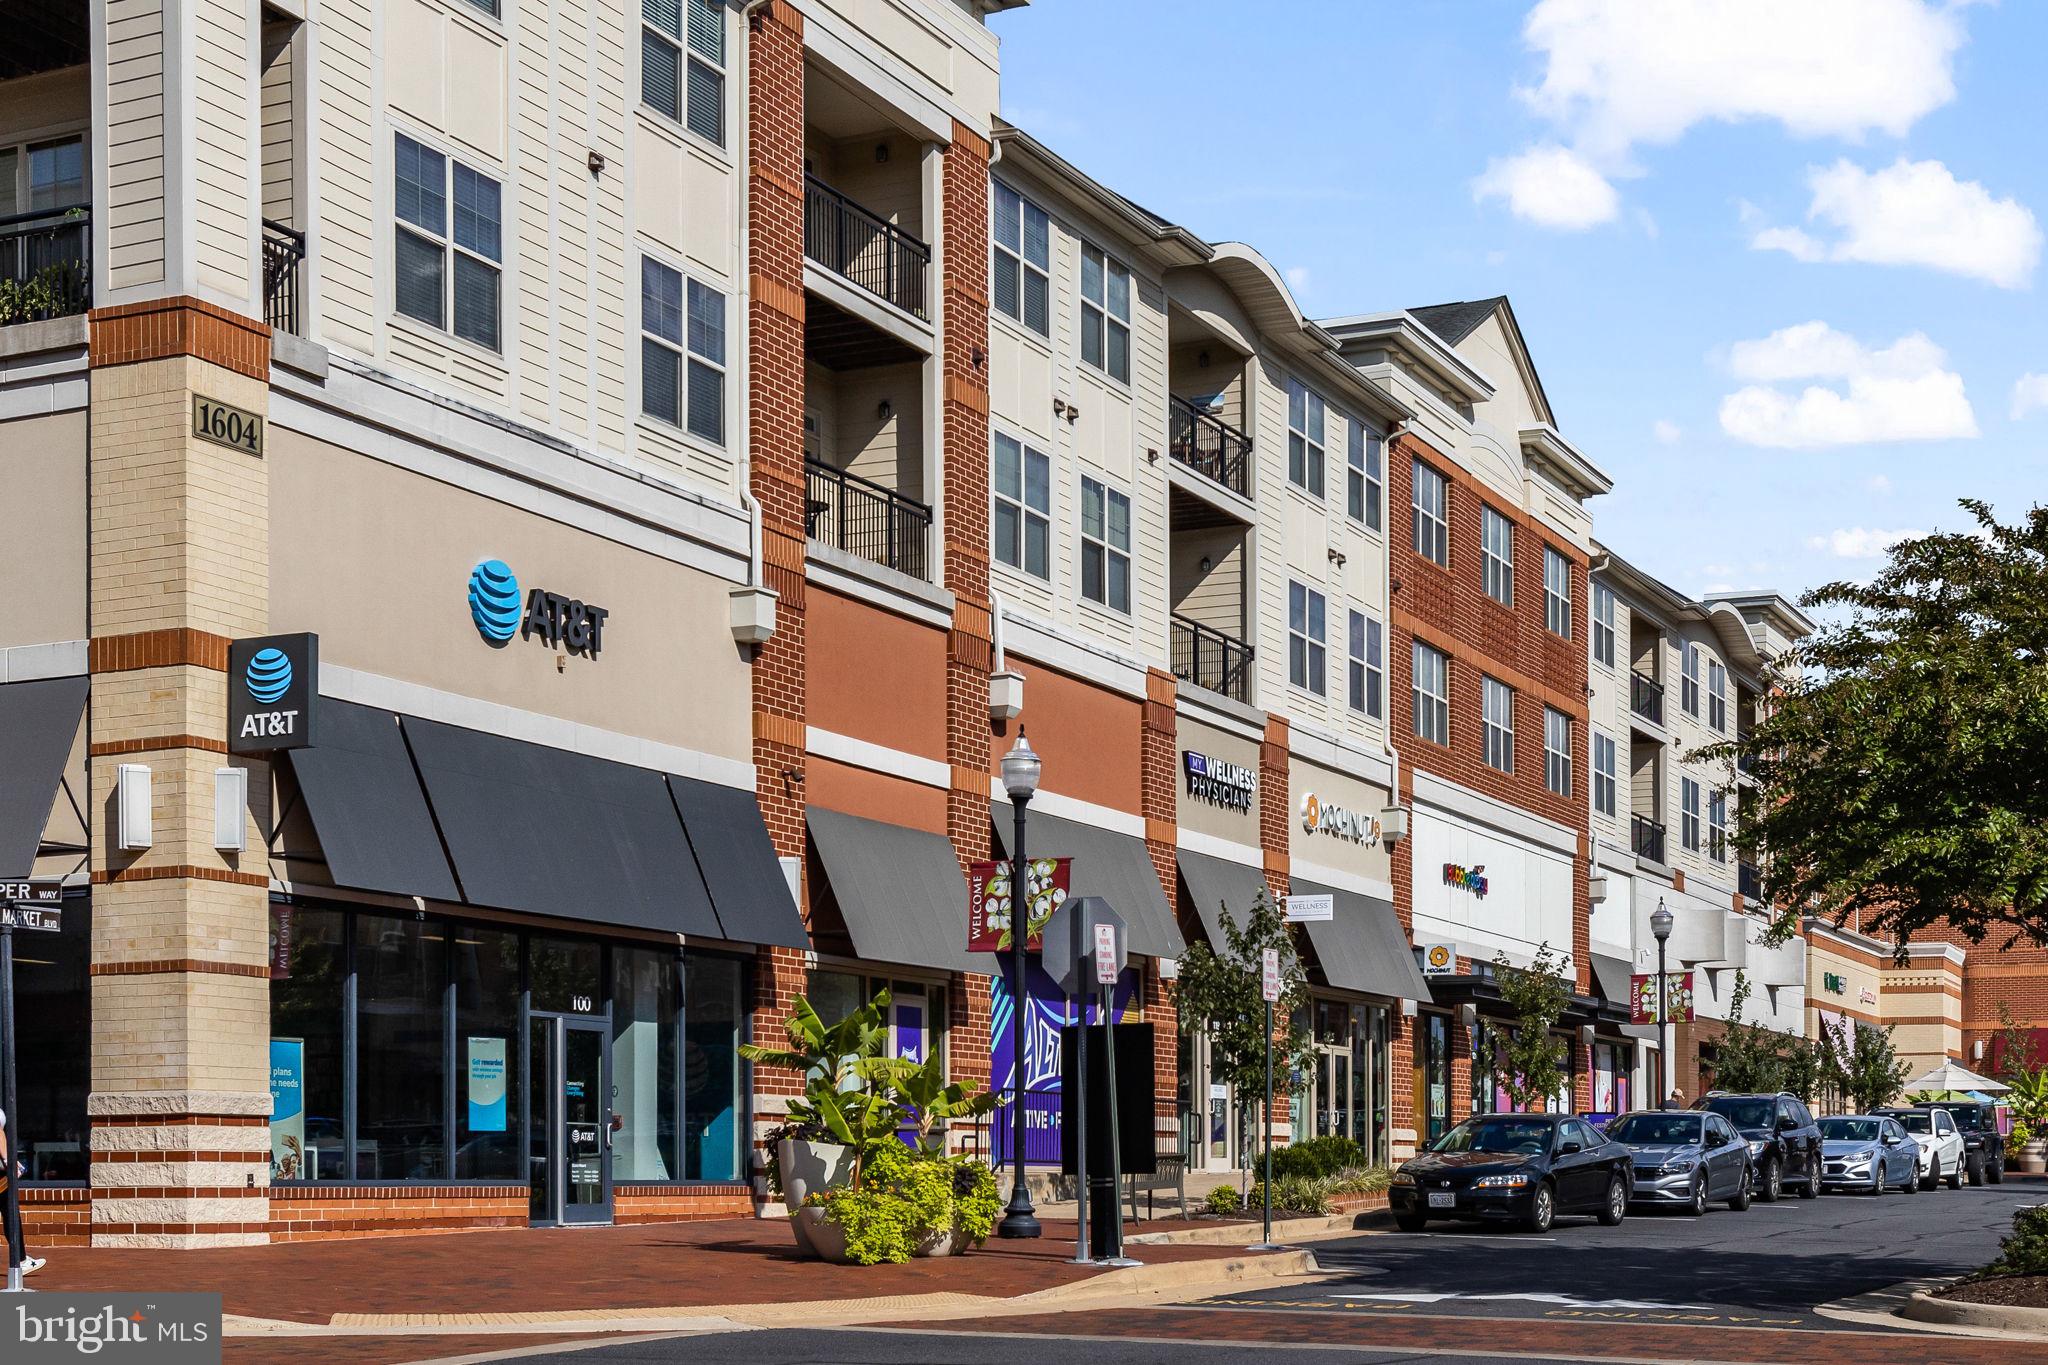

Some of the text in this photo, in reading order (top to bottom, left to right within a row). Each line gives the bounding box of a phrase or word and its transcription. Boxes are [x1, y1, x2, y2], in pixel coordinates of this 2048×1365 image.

[199, 403, 258, 450] 1604
[522, 588, 609, 656] AT&T
[240, 710, 298, 738] AT&T
[1192, 756, 1256, 792] MY WELLNESS
[1192, 776, 1252, 810] PHYSICIANS
[39, 890, 58, 899] WAY
[1291, 902, 1328, 910] WELLNESS
[2, 908, 58, 928] MARKET BLVD
[972, 875, 982, 940] WELCOME
[573, 995, 591, 1012] 100
[1632, 981, 1640, 1018] WELCOME
[272, 1067, 292, 1077] plans
[278, 1079, 299, 1088] needs
[580, 1132, 596, 1141] AT&T
